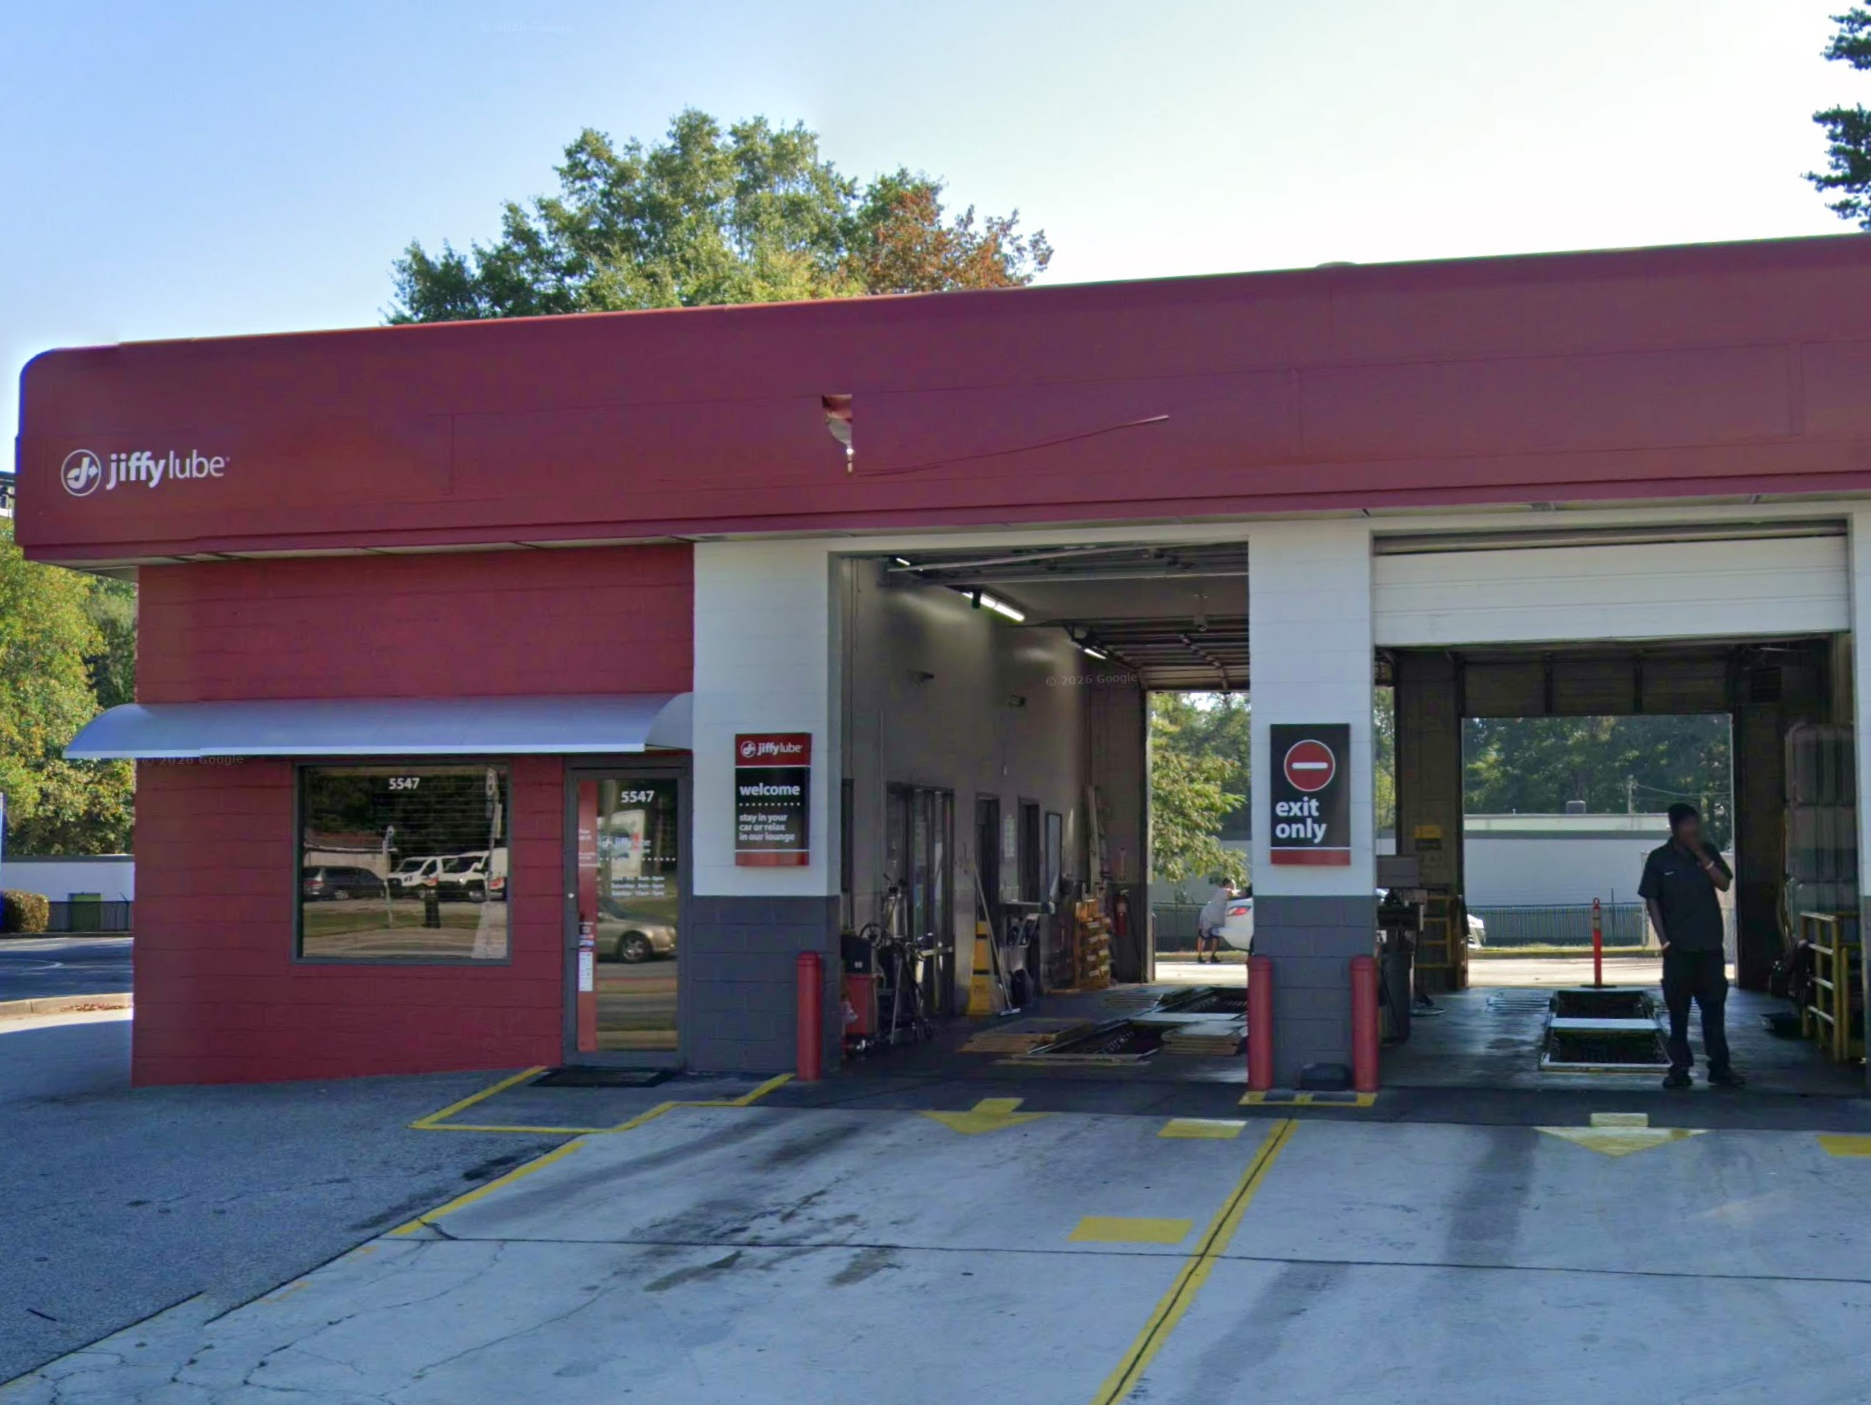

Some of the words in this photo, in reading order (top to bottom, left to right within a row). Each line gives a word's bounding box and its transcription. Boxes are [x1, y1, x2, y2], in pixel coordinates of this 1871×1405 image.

[106, 451, 166, 490] jiffy
[757, 743, 780, 756] jiffy
[388, 777, 420, 790] 5547
[739, 782, 800, 796] welcome
[621, 790, 655, 803] 5547
[1275, 795, 1319, 817] exit
[739, 813, 756, 824] stay
[758, 813, 766, 821] in
[767, 814, 787, 824] your
[739, 823, 752, 831] car
[753, 823, 763, 831] or
[764, 822, 786, 831] relax
[1275, 818, 1327, 844] only
[739, 832, 748, 841] in
[749, 833, 763, 841] our
[765, 832, 795, 843] lounge
